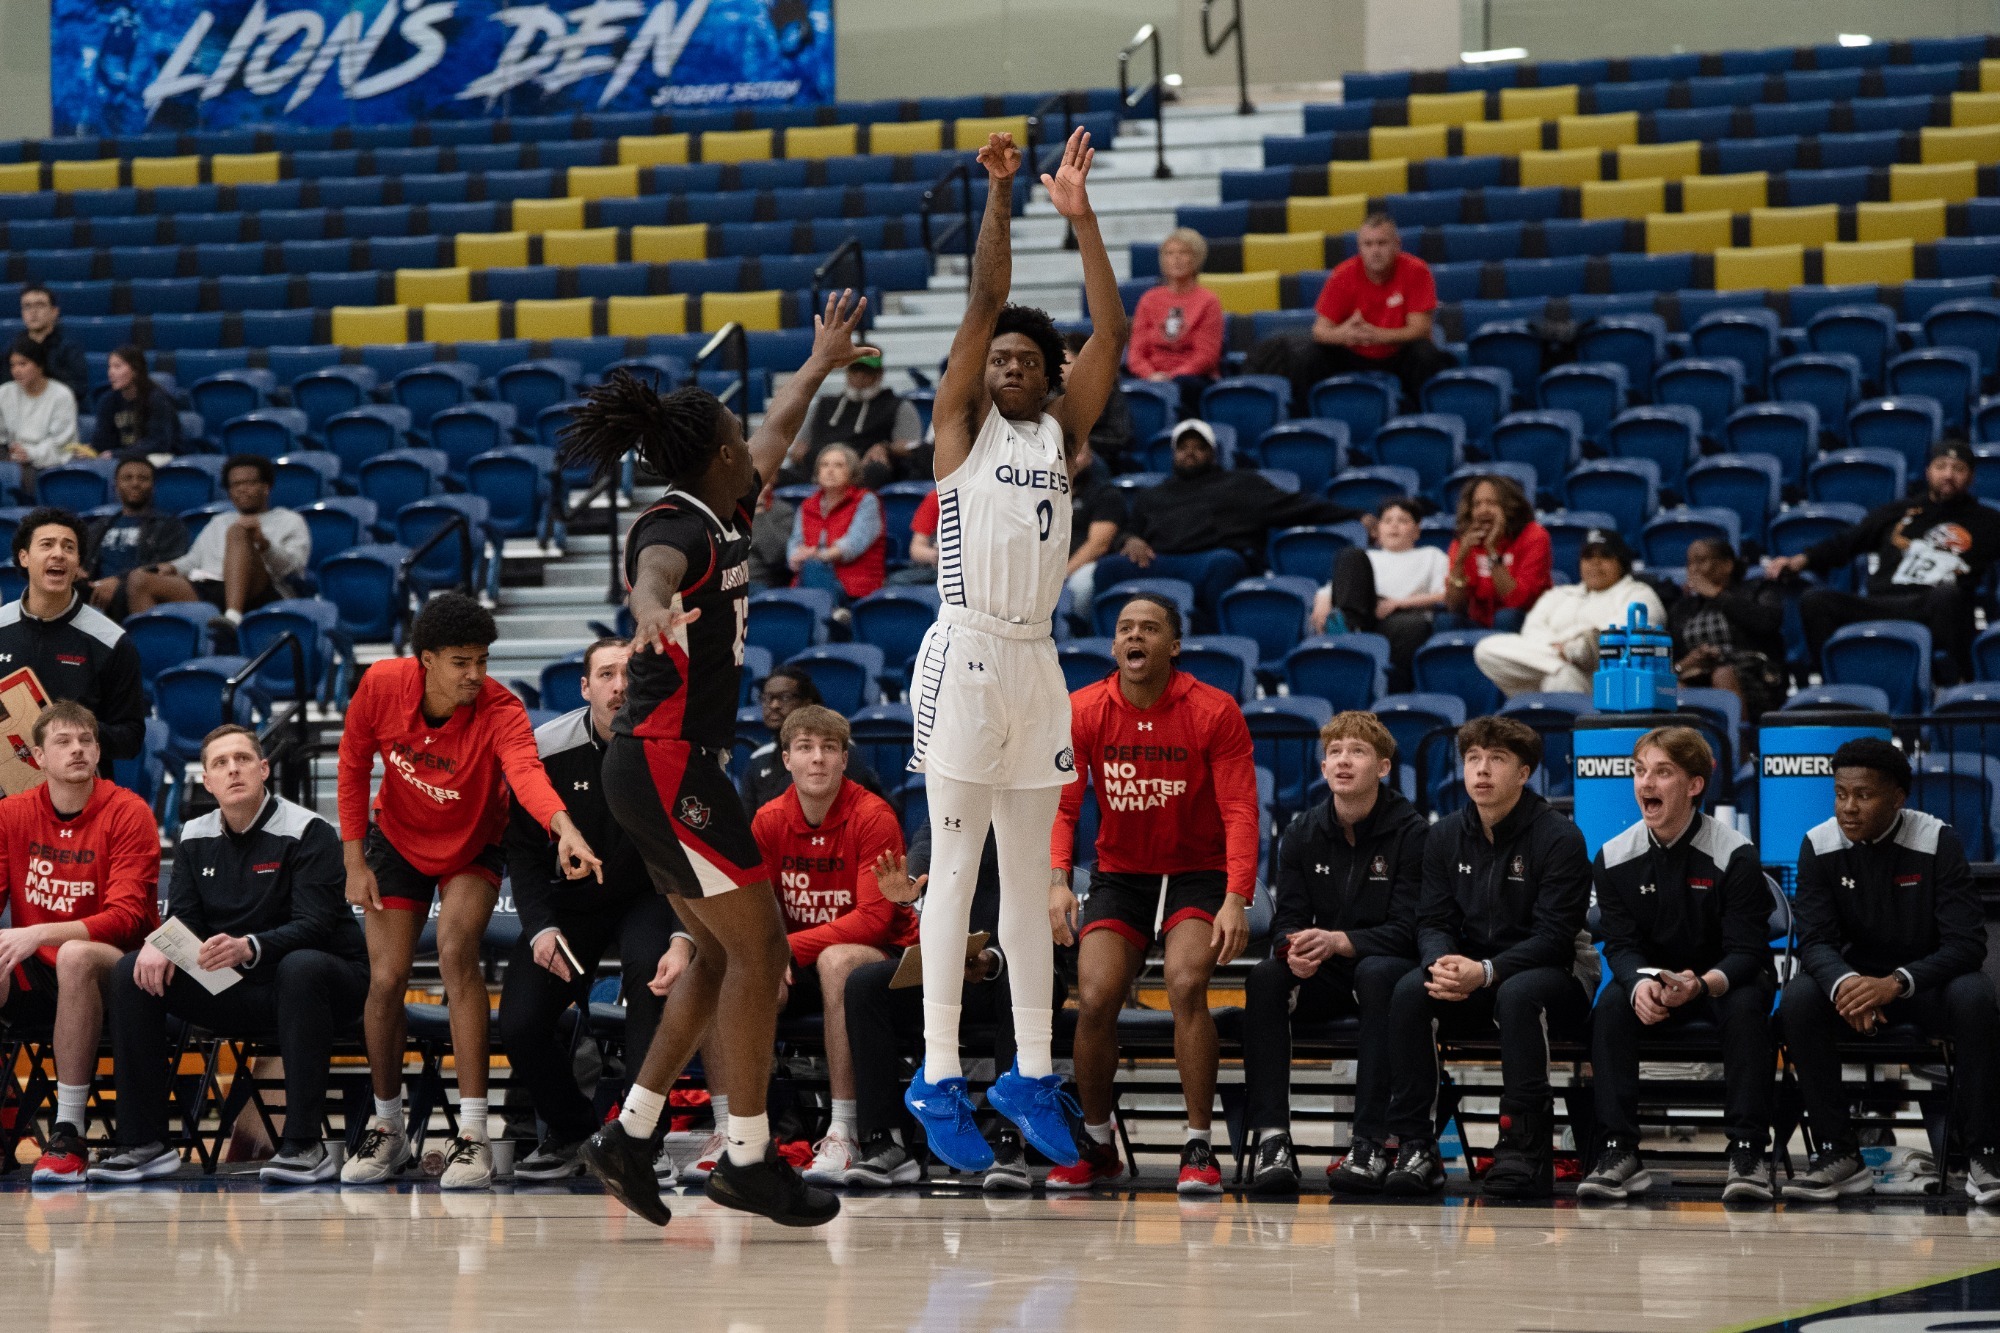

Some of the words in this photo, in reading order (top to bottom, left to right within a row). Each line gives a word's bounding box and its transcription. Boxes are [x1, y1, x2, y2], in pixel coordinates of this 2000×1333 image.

[455, 0, 707, 110] DEN
[389, 750, 416, 773] NO
[1103, 745, 1188, 762] DEFEND
[1103, 762, 1136, 779] NO
[1105, 778, 1187, 796] MATTER
[1106, 793, 1167, 812] WHAT
[29, 840, 96, 865] DEFEND
[29, 855, 54, 876] NO
[25, 871, 96, 897] MATTER
[781, 871, 810, 889] NO
[25, 887, 77, 913] WHAT
[785, 903, 838, 923] WHAT
